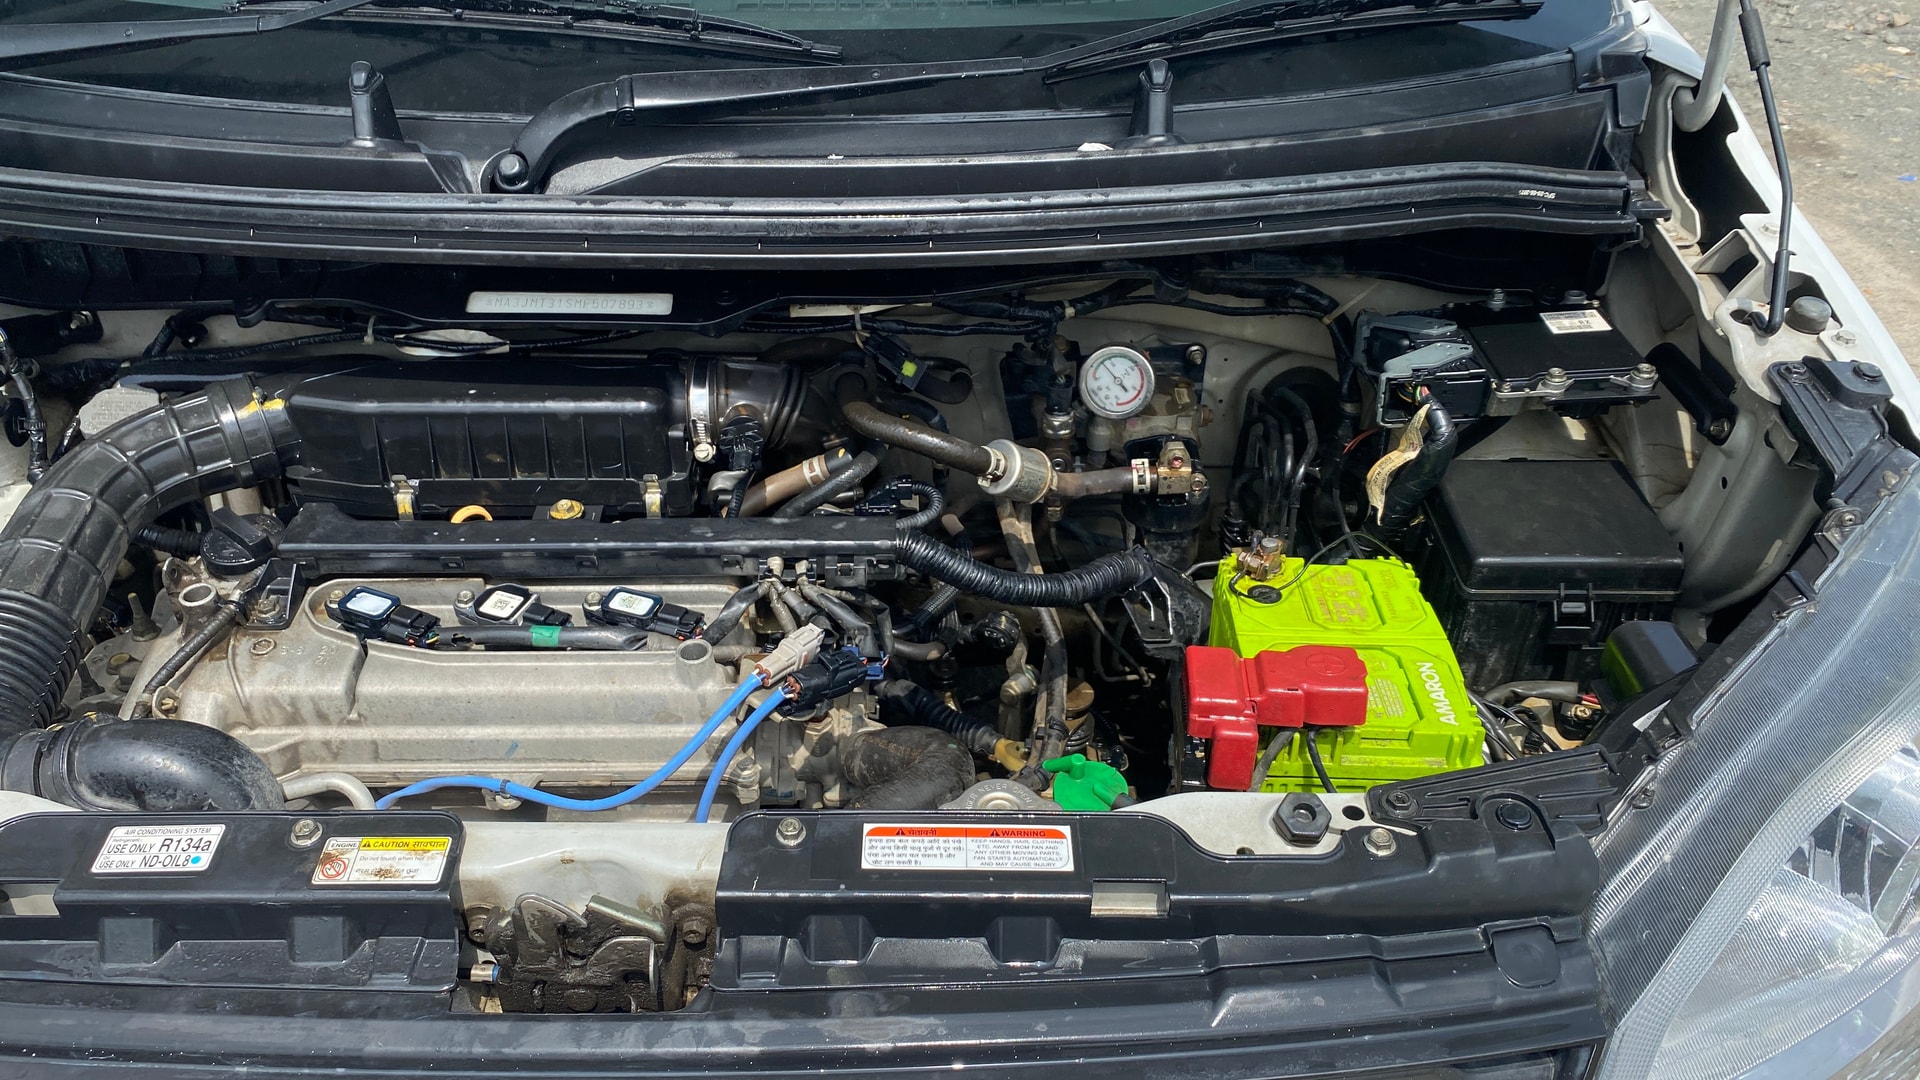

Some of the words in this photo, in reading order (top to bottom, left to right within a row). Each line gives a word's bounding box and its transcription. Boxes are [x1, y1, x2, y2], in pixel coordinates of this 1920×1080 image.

[1416, 662, 1459, 726] AMARON
[978, 783, 1007, 792] NEVER
[1013, 787, 1032, 802] OPEN
[107, 844, 128, 853] USE
[129, 843, 156, 853] ONLY
[158, 837, 212, 852] R134a
[100, 860, 116, 868] USE
[116, 860, 135, 868] ONLY
[139, 855, 191, 867] ND-OIL8
